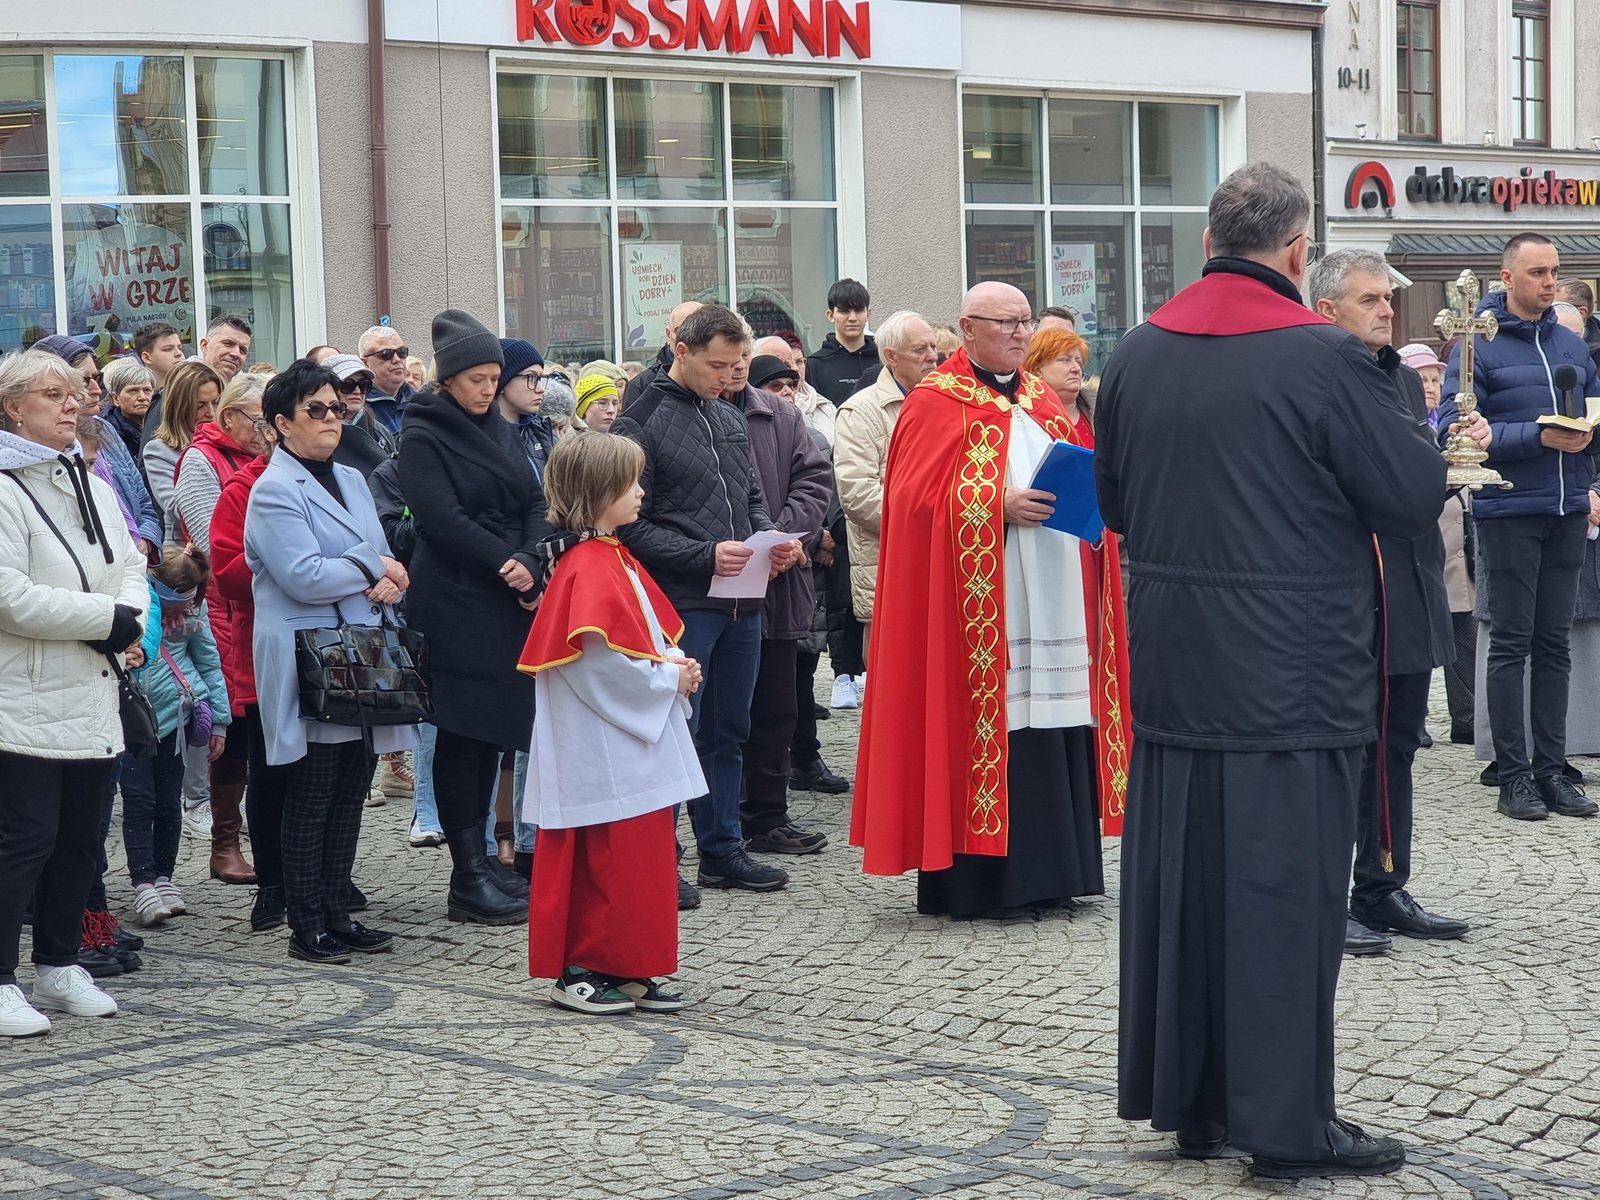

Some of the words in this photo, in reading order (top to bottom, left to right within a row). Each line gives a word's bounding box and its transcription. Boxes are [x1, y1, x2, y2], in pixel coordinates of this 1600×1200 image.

[516, 0, 872, 60] ROSSMANN
[1337, 67, 1370, 90] 10-11
[96, 243, 183, 276] WITAJ
[651, 271, 676, 287] DZIEŃ
[88, 281, 114, 311] W
[126, 277, 190, 308] GRZE
[638, 286, 667, 301] DOBRY
[1061, 283, 1086, 296] DOBRY
[126, 315, 142, 323] PULA
[143, 312, 167, 322] NAGRÓD
